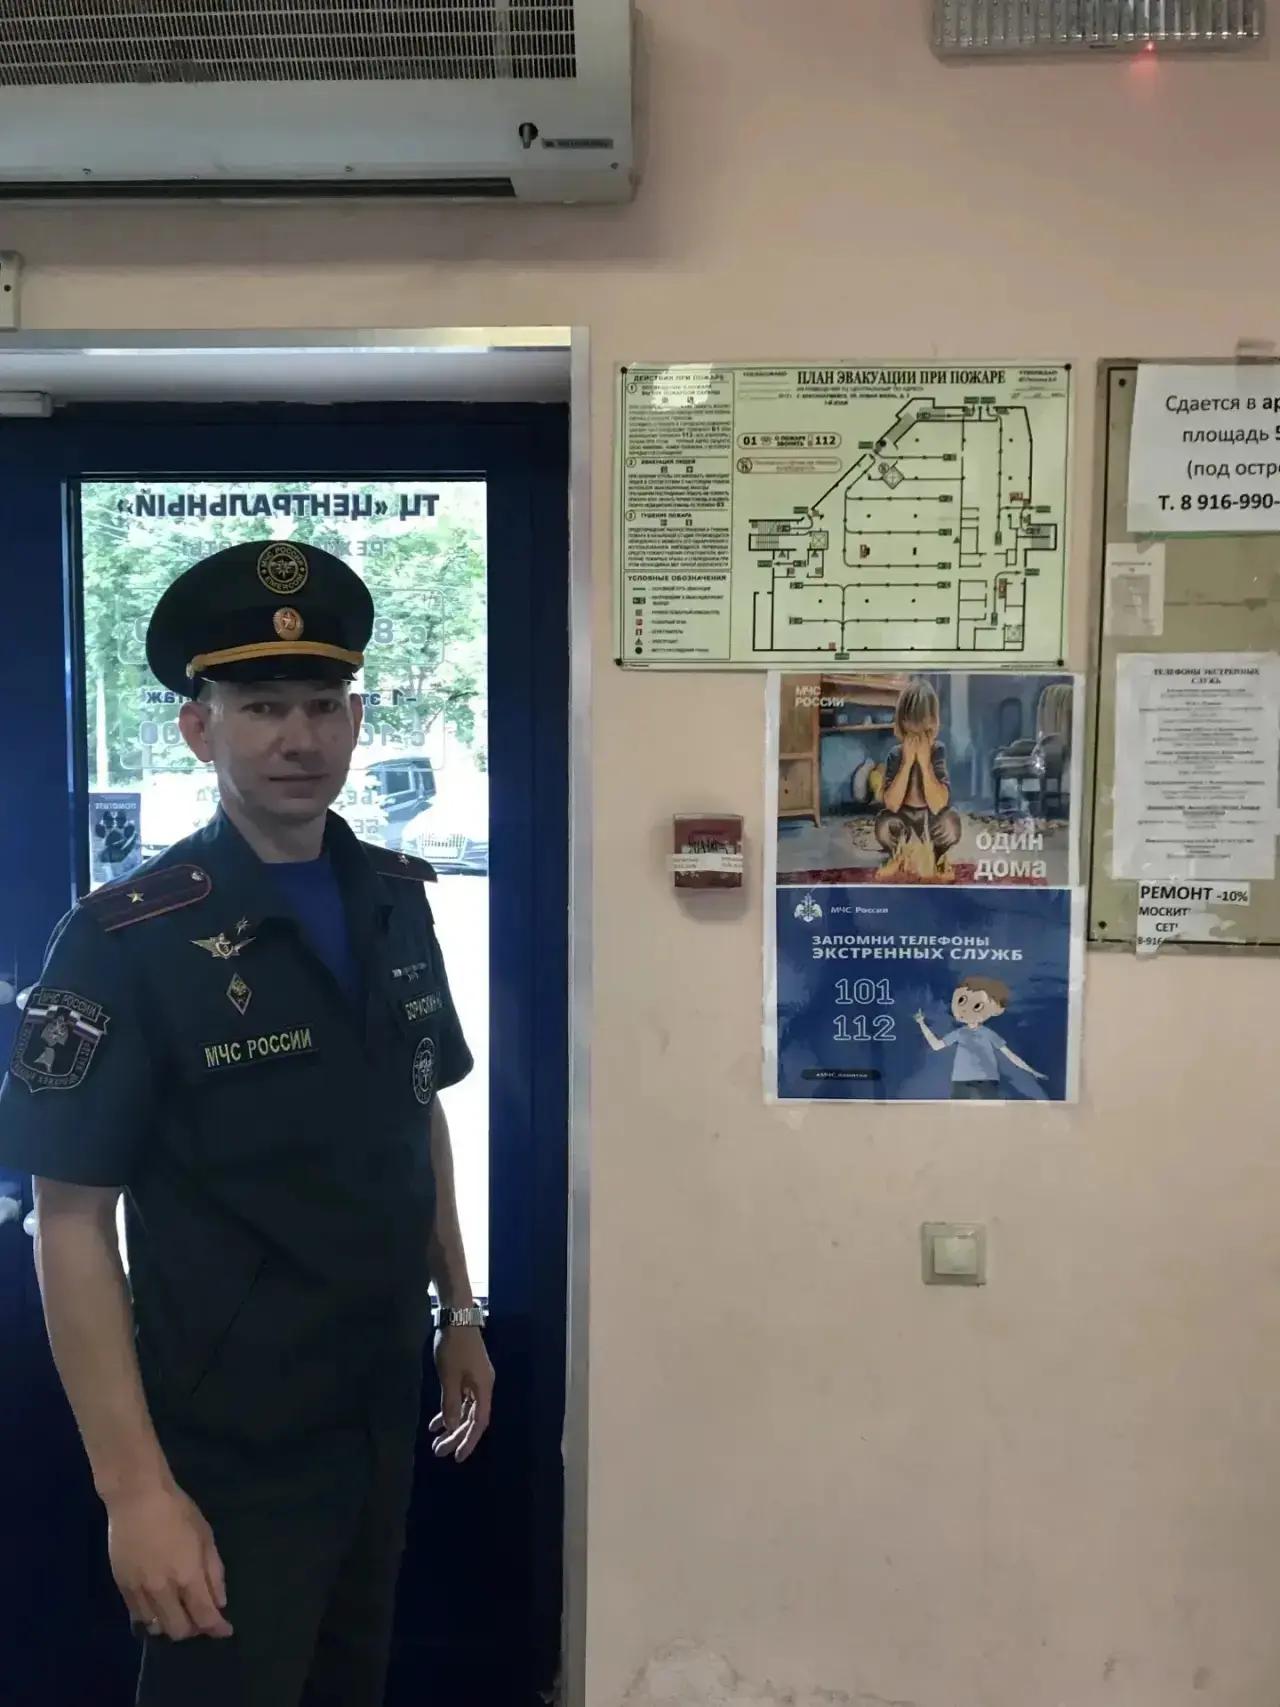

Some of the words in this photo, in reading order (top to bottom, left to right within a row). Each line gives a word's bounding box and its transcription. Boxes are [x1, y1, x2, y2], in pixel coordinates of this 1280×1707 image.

[797, 370, 834, 384] ПЛАН
[837, 370, 916, 387] ЭВАКУАЦИИ
[920, 370, 947, 385] ПРИ
[950, 370, 1006, 385] ПОЖАРЕ
[1166, 395, 1240, 414] Сдается
[1247, 398, 1257, 410] в
[743, 436, 757, 446] 01
[815, 436, 836, 445] 112
[1183, 429, 1269, 444] площадь
[1187, 460, 1230, 480] (под
[1235, 462, 1280, 479] остр
[1158, 494, 1174, 511] Т.
[1180, 494, 1192, 511] 8
[1197, 493, 1280, 511] 916-990-
[795, 685, 820, 696] МЧС
[795, 696, 845, 707] РОССИИ
[975, 831, 1044, 854] один
[974, 859, 1047, 881] дома
[1140, 885, 1214, 900] РЕМОНТ
[1216, 890, 1249, 902] -10%
[830, 906, 852, 914] МЧС
[1139, 907, 1192, 917] МОСКИТ
[812, 936, 895, 945] ЗАПОМНИ
[899, 936, 990, 946] ТЕЛЕФОНЫ
[811, 948, 945, 960] ЭКСТРЕННЫХ
[949, 948, 1024, 961] СЛУЖБ
[834, 978, 895, 1005] 101
[833, 1014, 897, 1041] 112
[204, 1042, 242, 1068] МЧС
[246, 1027, 313, 1059] РОССИИ
